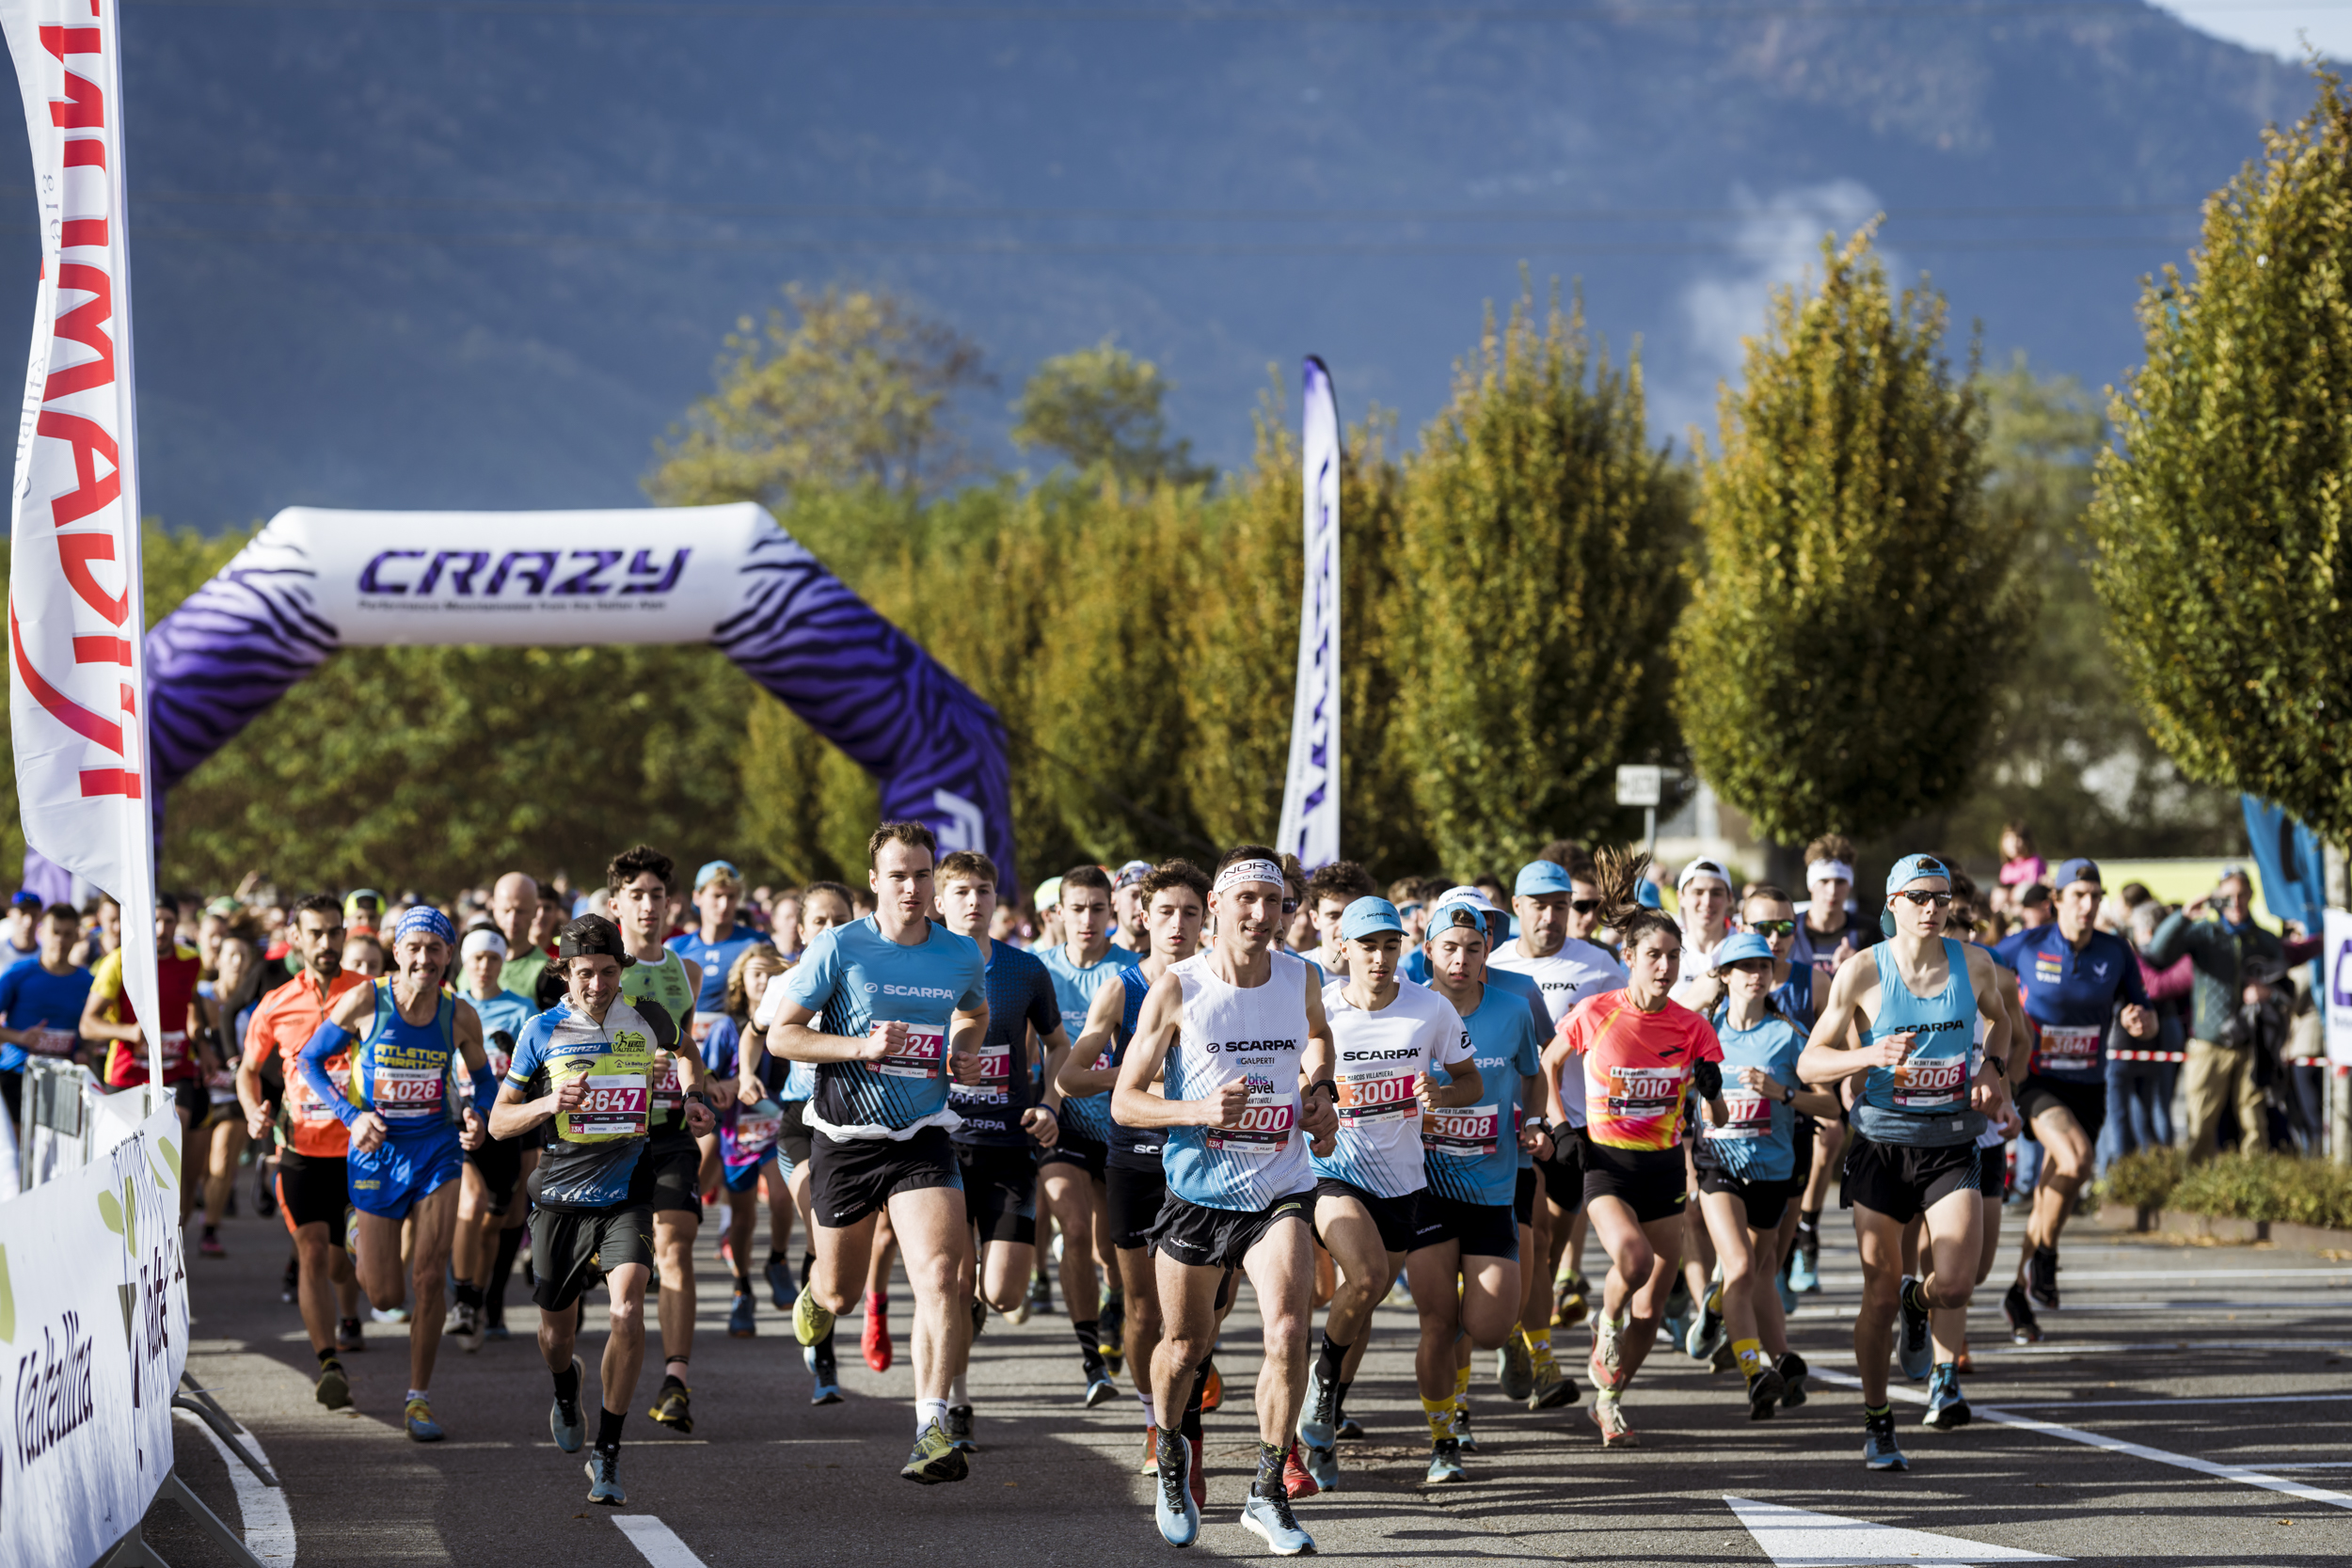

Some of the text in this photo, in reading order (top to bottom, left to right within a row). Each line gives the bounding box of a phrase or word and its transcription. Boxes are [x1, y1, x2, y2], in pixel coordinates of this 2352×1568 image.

[358, 550, 690, 594] CRAZY
[883, 984, 954, 1000] SCARPA
[1542, 983, 1579, 991] RPA
[1895, 1020, 1964, 1034] SCARPA
[374, 1043, 448, 1062] ATLETICA
[561, 1045, 601, 1054] CRAZY
[1226, 1039, 1296, 1052] SCARPA
[1343, 1047, 1420, 1061] SCARPA
[867, 1063, 880, 1071] 13K
[980, 1056, 1001, 1076] 21
[1241, 1056, 1275, 1065] GALPERTI
[1433, 1057, 1506, 1070] SRPA
[656, 1070, 677, 1089] 33
[1248, 1072, 1268, 1085] bhs
[1903, 1066, 1961, 1087] 3006
[381, 1081, 437, 1102] 4026
[1245, 1081, 1275, 1094] ravel
[1349, 1078, 1405, 1105] 3001
[1620, 1079, 1672, 1099] 3010
[580, 1089, 641, 1112] 3647
[1726, 1100, 1761, 1119] 017
[962, 1117, 1007, 1131] ARPA
[1223, 1107, 1288, 1130] 000
[1433, 1117, 1491, 1137] 3008
[1208, 1140, 1221, 1148] 13K
[16, 1310, 93, 1472] Valtellina
